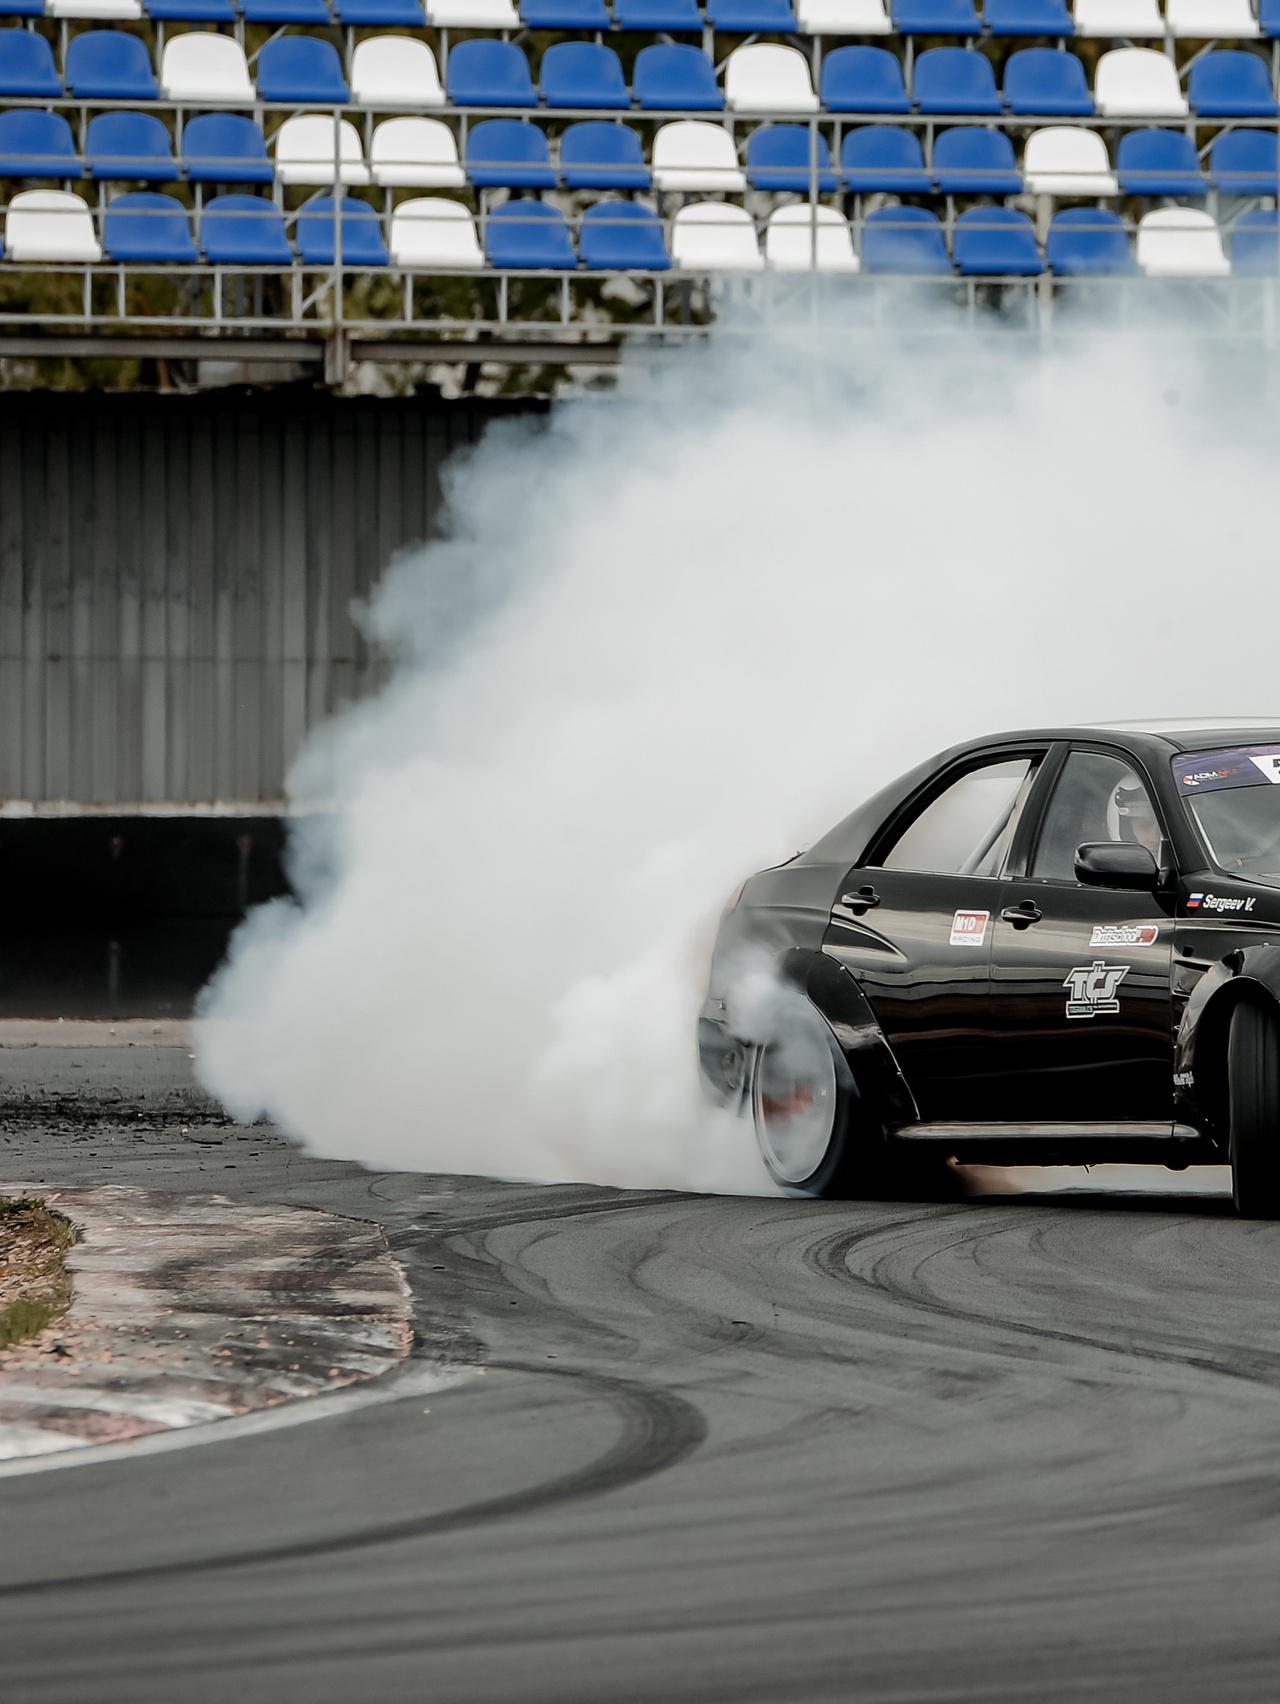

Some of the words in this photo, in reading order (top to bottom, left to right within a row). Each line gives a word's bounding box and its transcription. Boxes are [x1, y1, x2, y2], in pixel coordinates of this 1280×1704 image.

[1202, 894, 1245, 912] Sergeev
[1244, 897, 1256, 911] V.
[954, 916, 977, 931] M1D
[1067, 966, 1126, 1001] TCS
